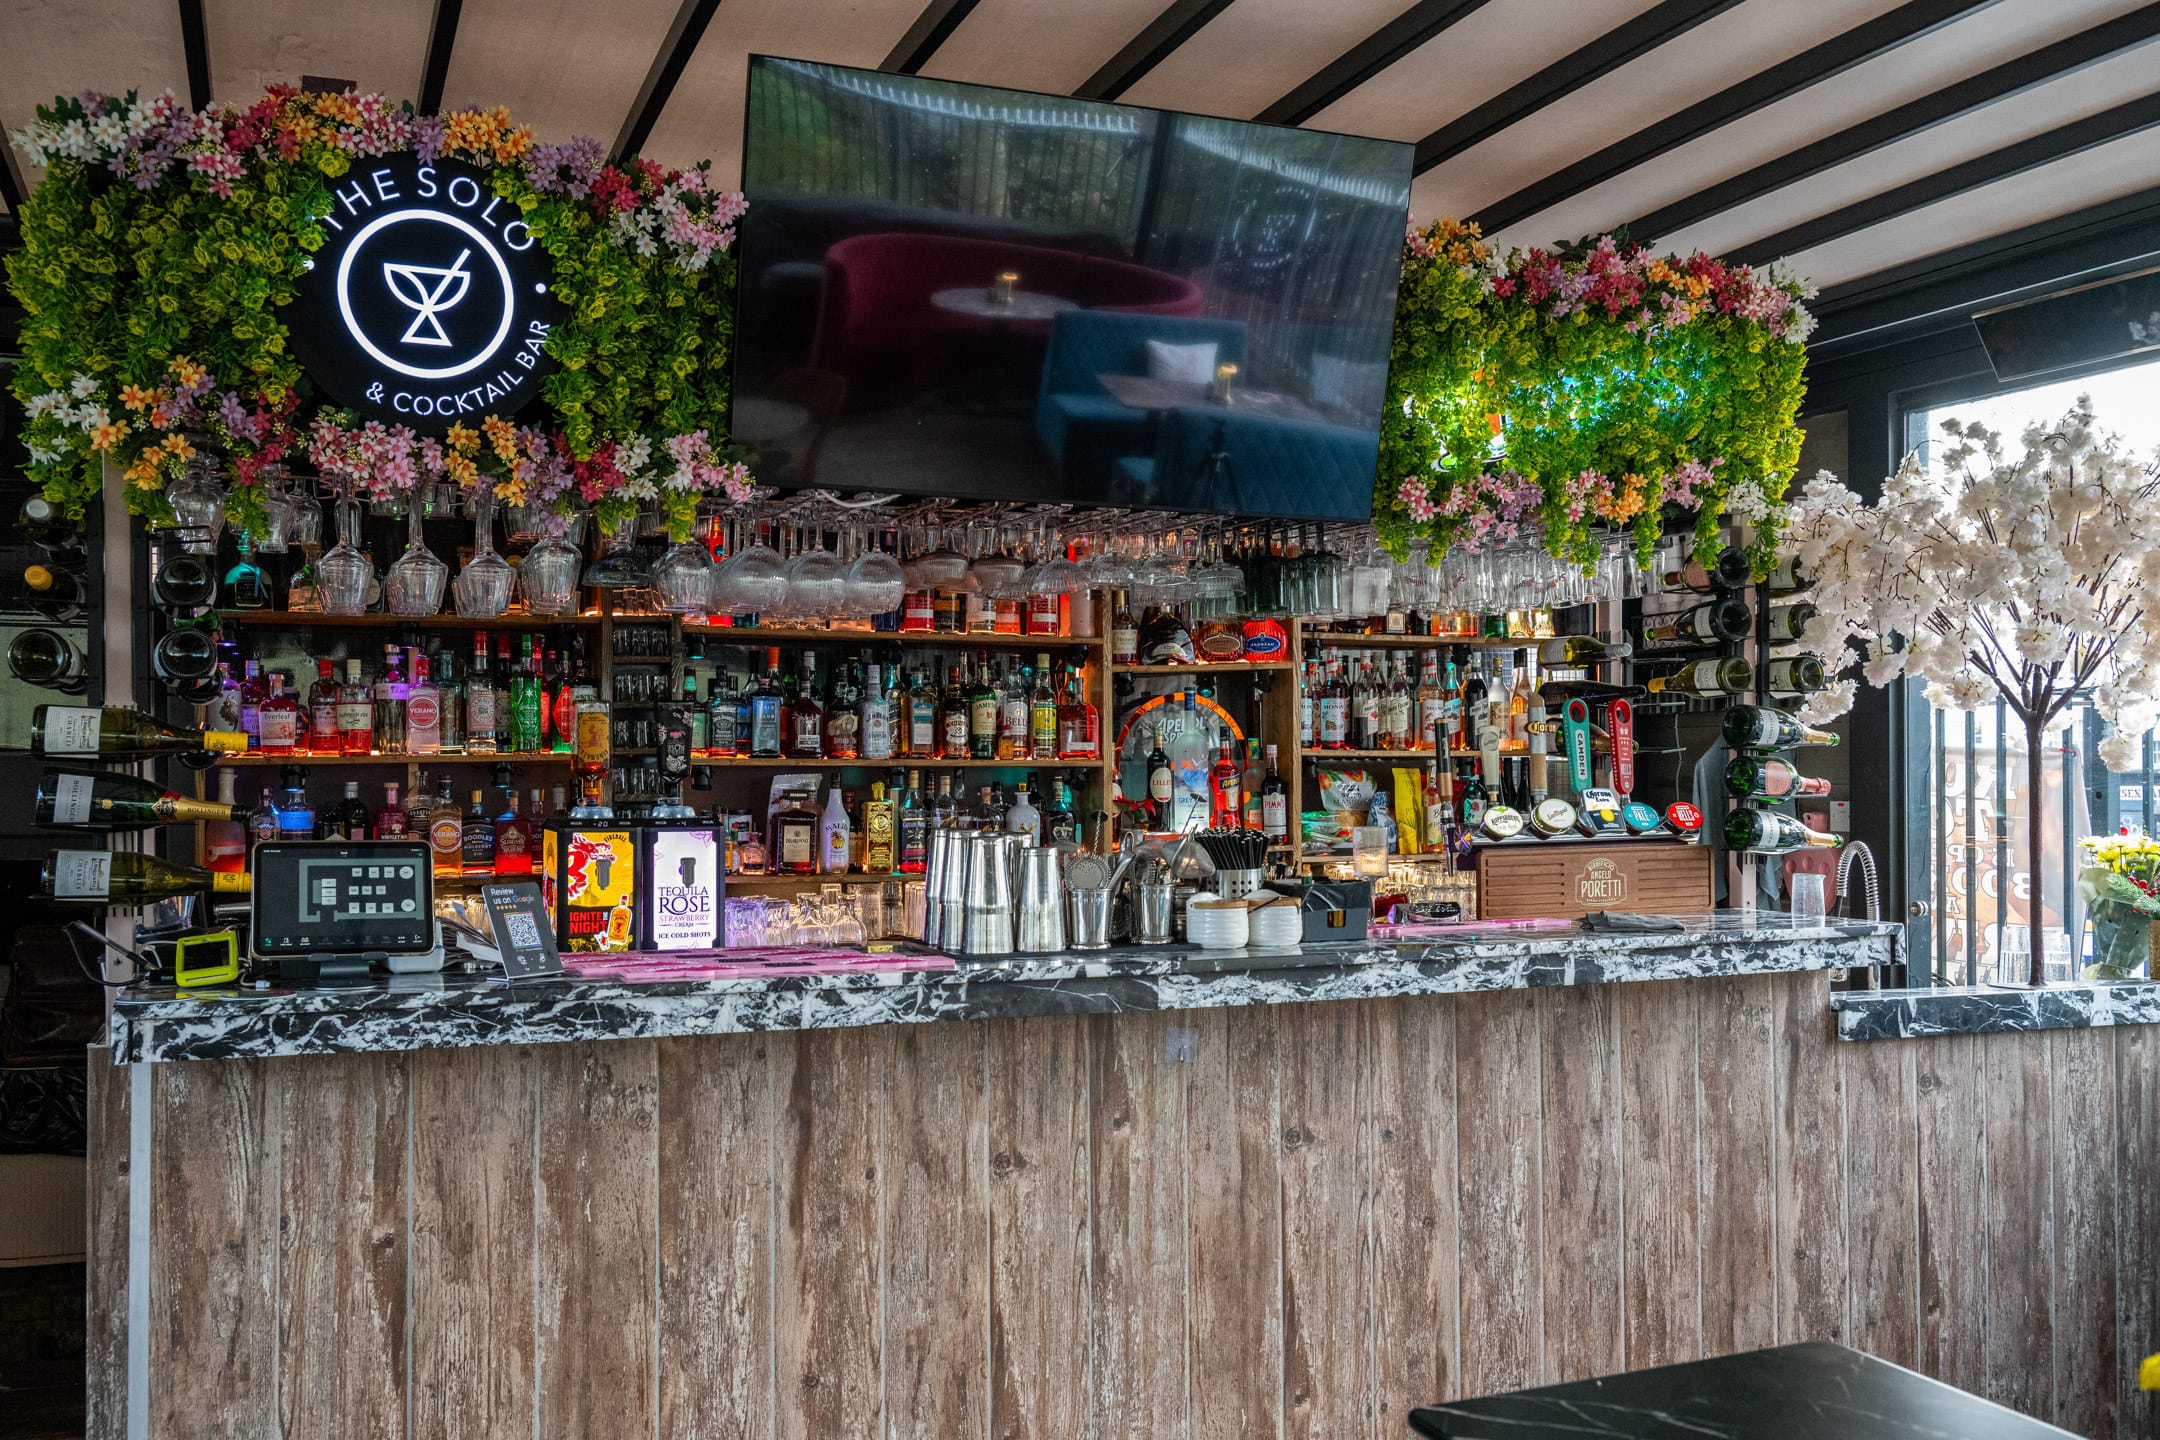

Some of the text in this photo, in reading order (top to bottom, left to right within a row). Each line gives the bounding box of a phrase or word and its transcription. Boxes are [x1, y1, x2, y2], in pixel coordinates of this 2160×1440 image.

[417, 167, 534, 251] SOLO
[366, 319, 550, 416] & COCKTAIL BAR
[1577, 733, 1586, 776] CAMDEN
[187, 806, 227, 816] BOLLINGER
[1632, 810, 1651, 821] PALE
[433, 831, 461, 839] VERANO
[463, 834, 493, 842] BOODLES
[604, 833, 627, 843] FIREBALL
[1591, 871, 1612, 879] ANGELO
[490, 888, 514, 896] Review
[658, 886, 709, 896] TEQUILA
[1581, 880, 1621, 898] PORETTI
[512, 894, 535, 904] Google
[658, 896, 710, 915] ROSE
[569, 911, 602, 921] IGNITE
[659, 914, 710, 923] STRAWBERRY
[569, 921, 609, 934] NIGHT
